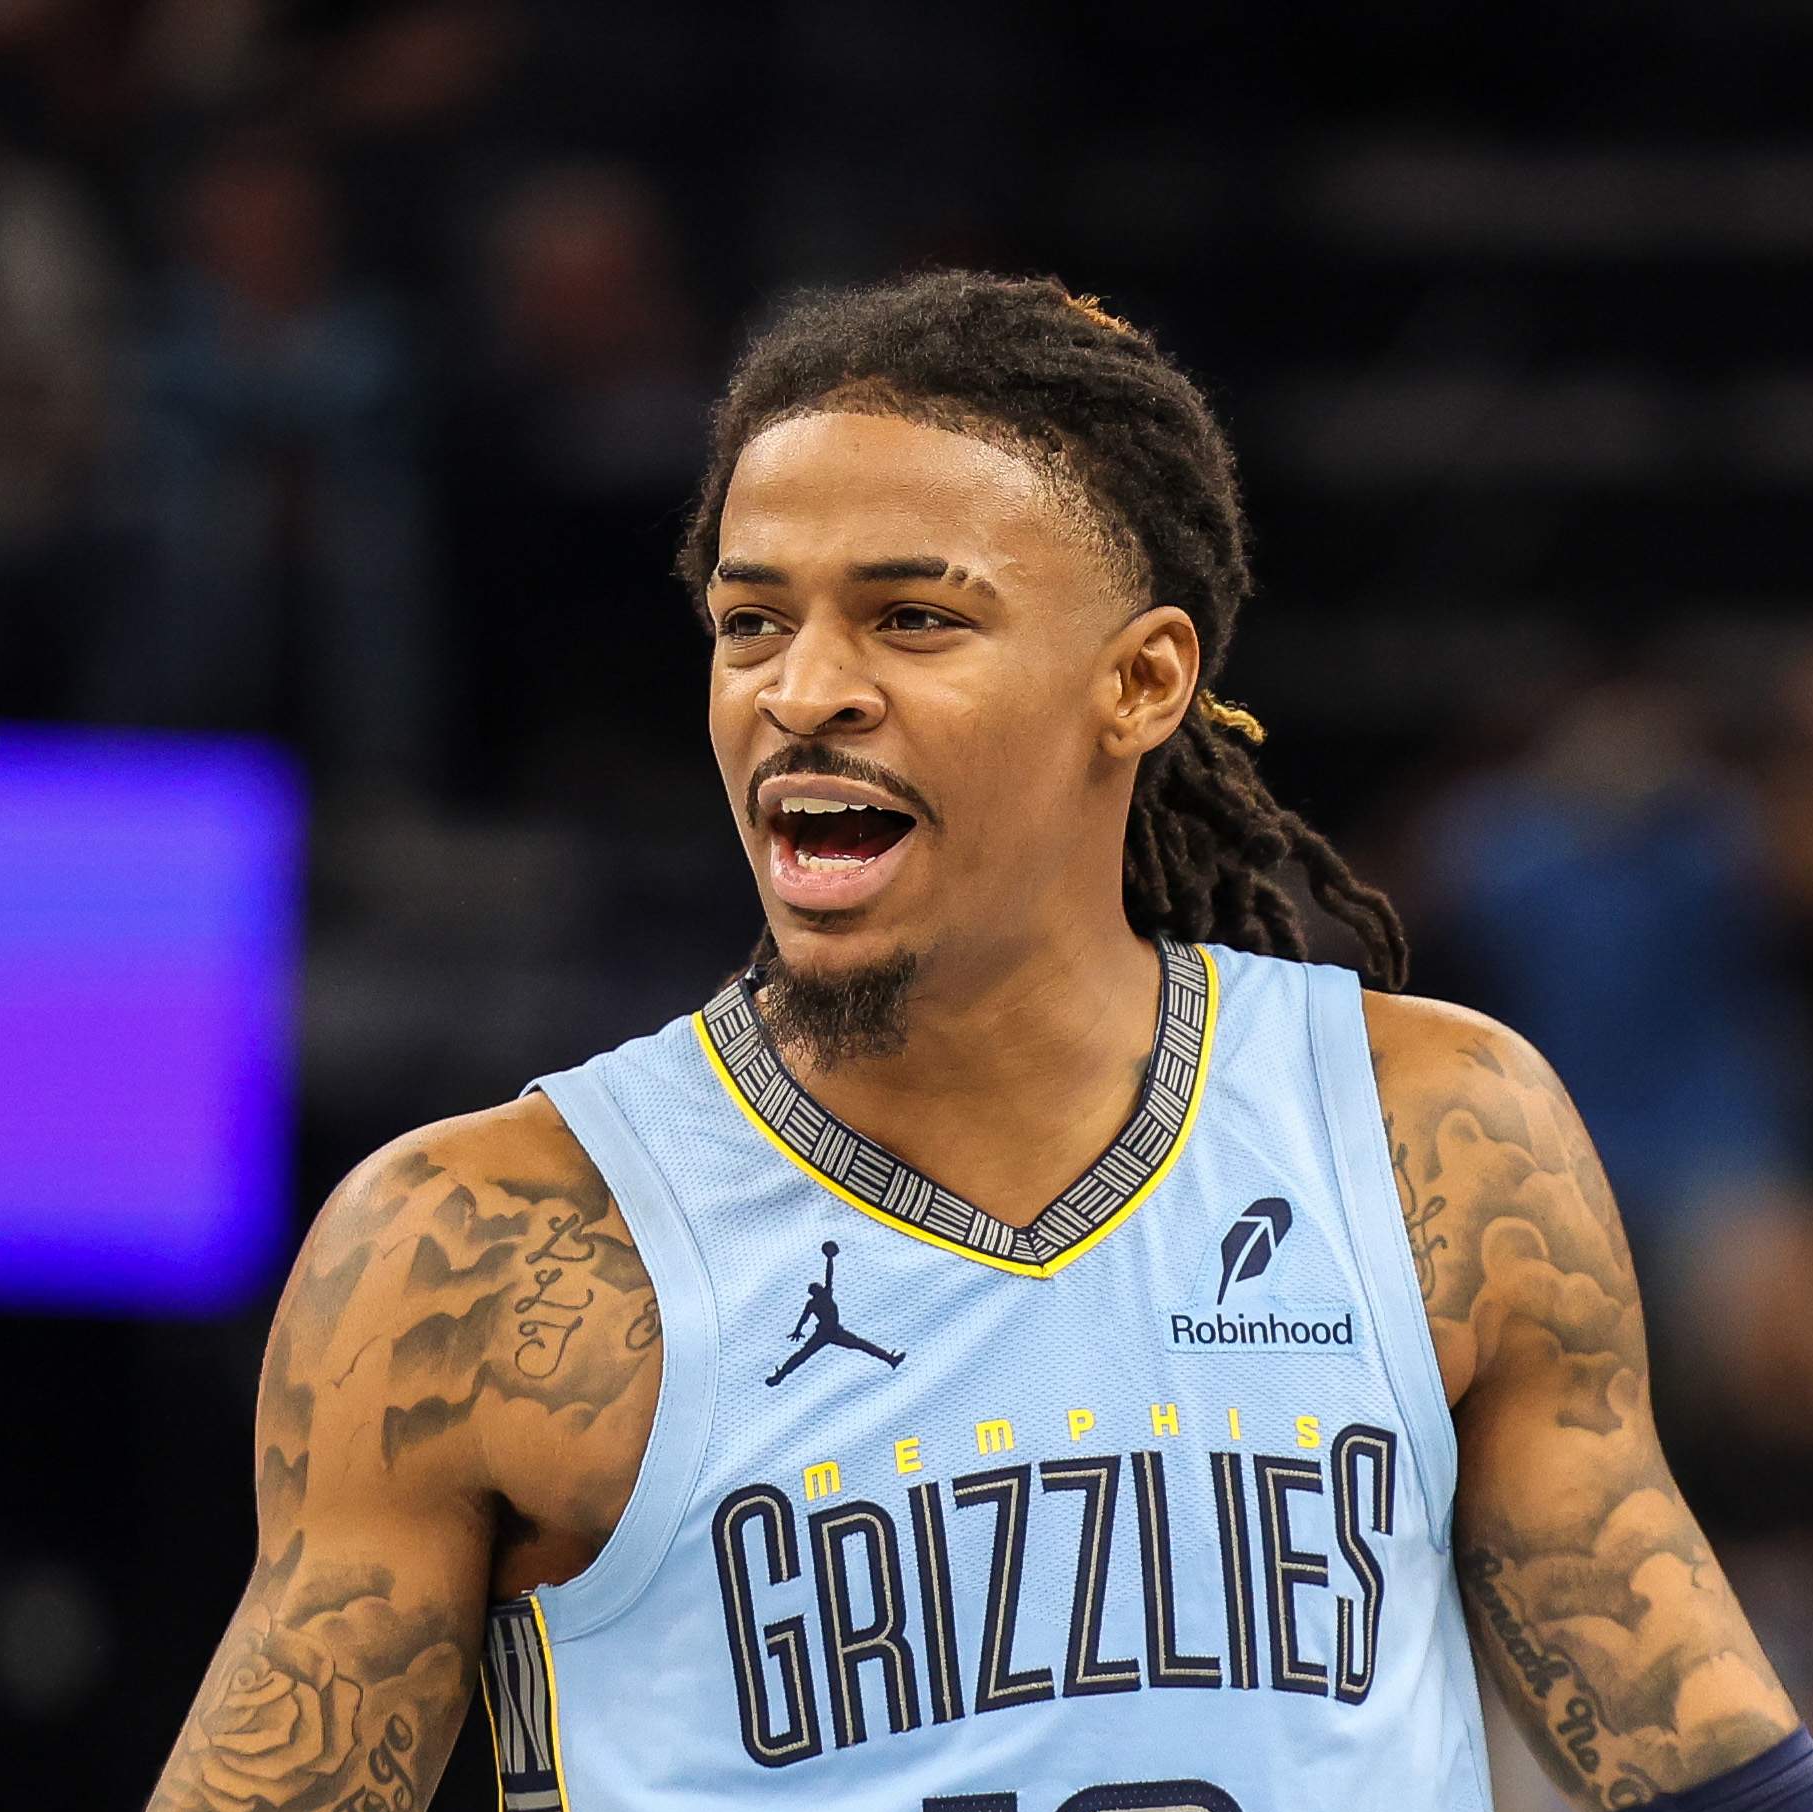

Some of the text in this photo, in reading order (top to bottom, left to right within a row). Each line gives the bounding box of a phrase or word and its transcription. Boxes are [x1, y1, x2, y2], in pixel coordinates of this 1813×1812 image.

[1171, 1310, 1354, 1346] Robinhood
[803, 1402, 1321, 1502] MEMPHIS
[712, 1423, 1396, 1768] GRIZZLIES
